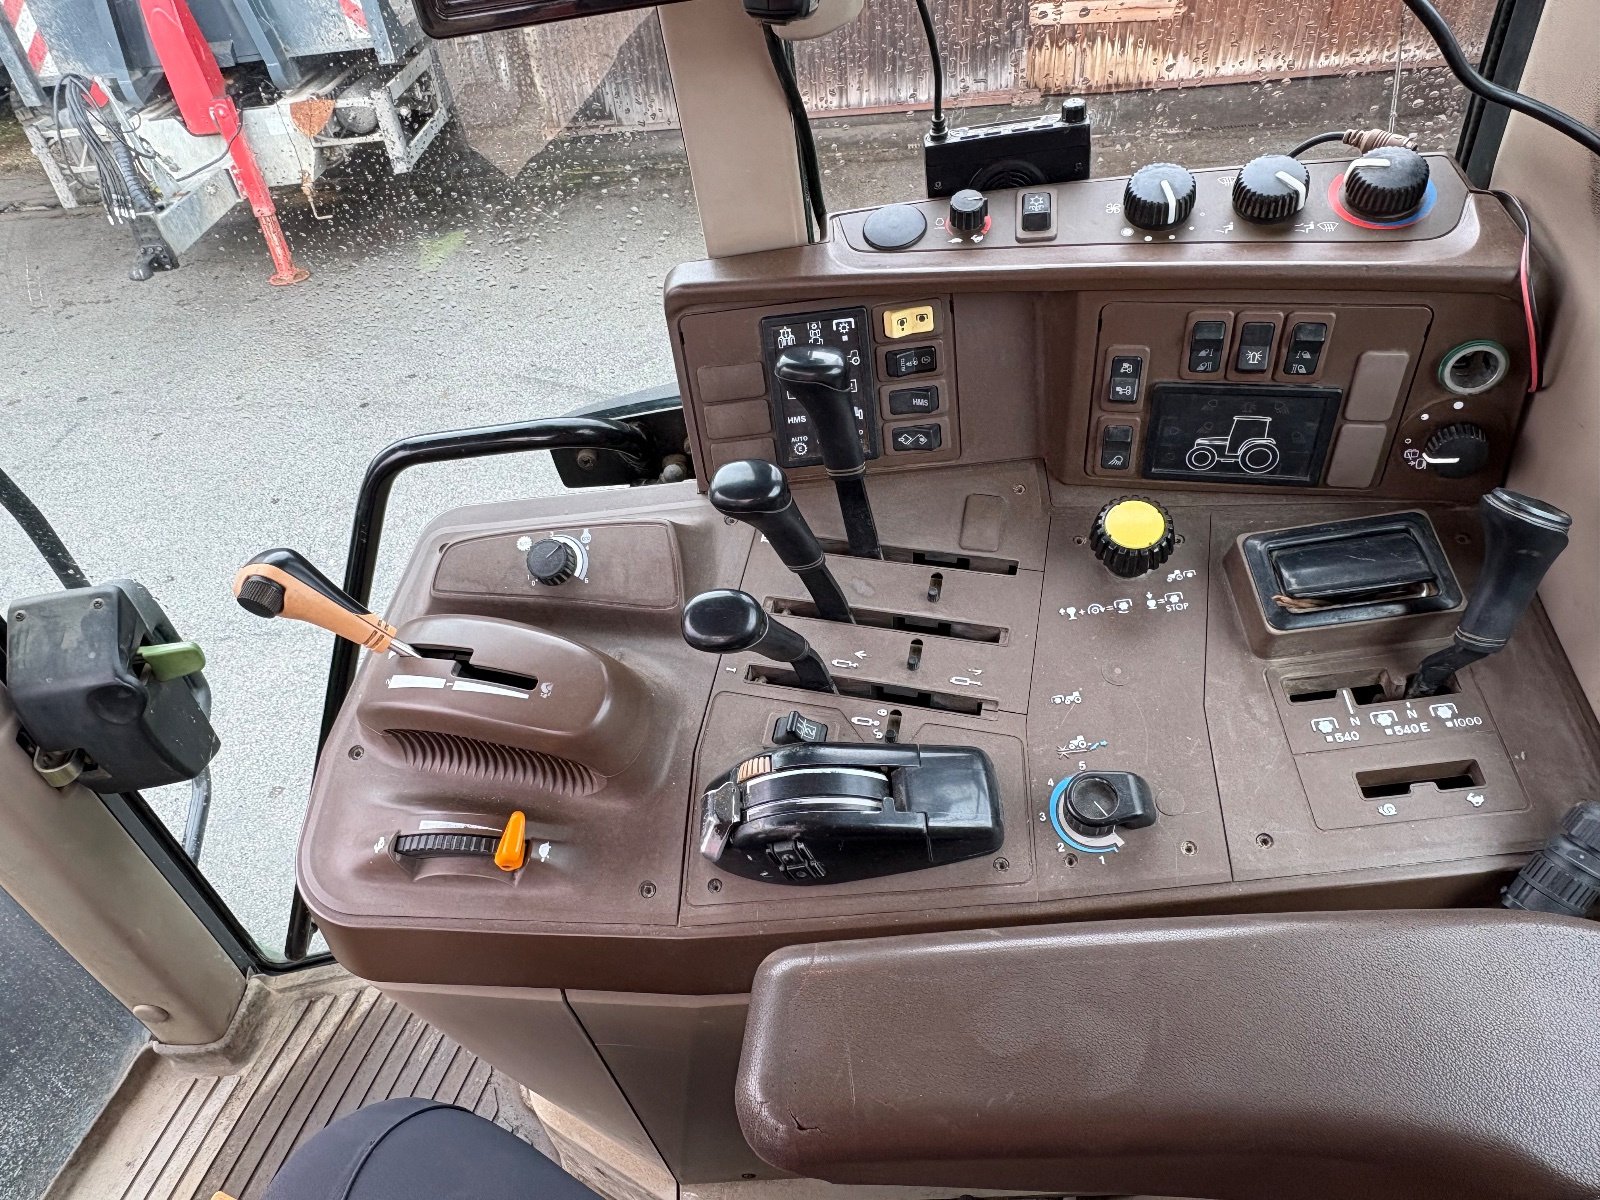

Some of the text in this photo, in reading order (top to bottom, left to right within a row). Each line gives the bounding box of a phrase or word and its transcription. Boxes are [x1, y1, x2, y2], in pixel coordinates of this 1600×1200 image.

[912, 398, 929, 407] HMS
[787, 415, 807, 424] HMS
[1165, 602, 1189, 613] STOP
[1406, 709, 1418, 719] N
[1350, 716, 1361, 727] N
[1454, 716, 1483, 728] 1000
[1334, 731, 1360, 743] 540
[1078, 760, 1087, 771] 5
[1047, 777, 1055, 787] 4
[1038, 811, 1047, 822] 3
[1056, 842, 1066, 853] 2
[1098, 855, 1106, 865] 1
